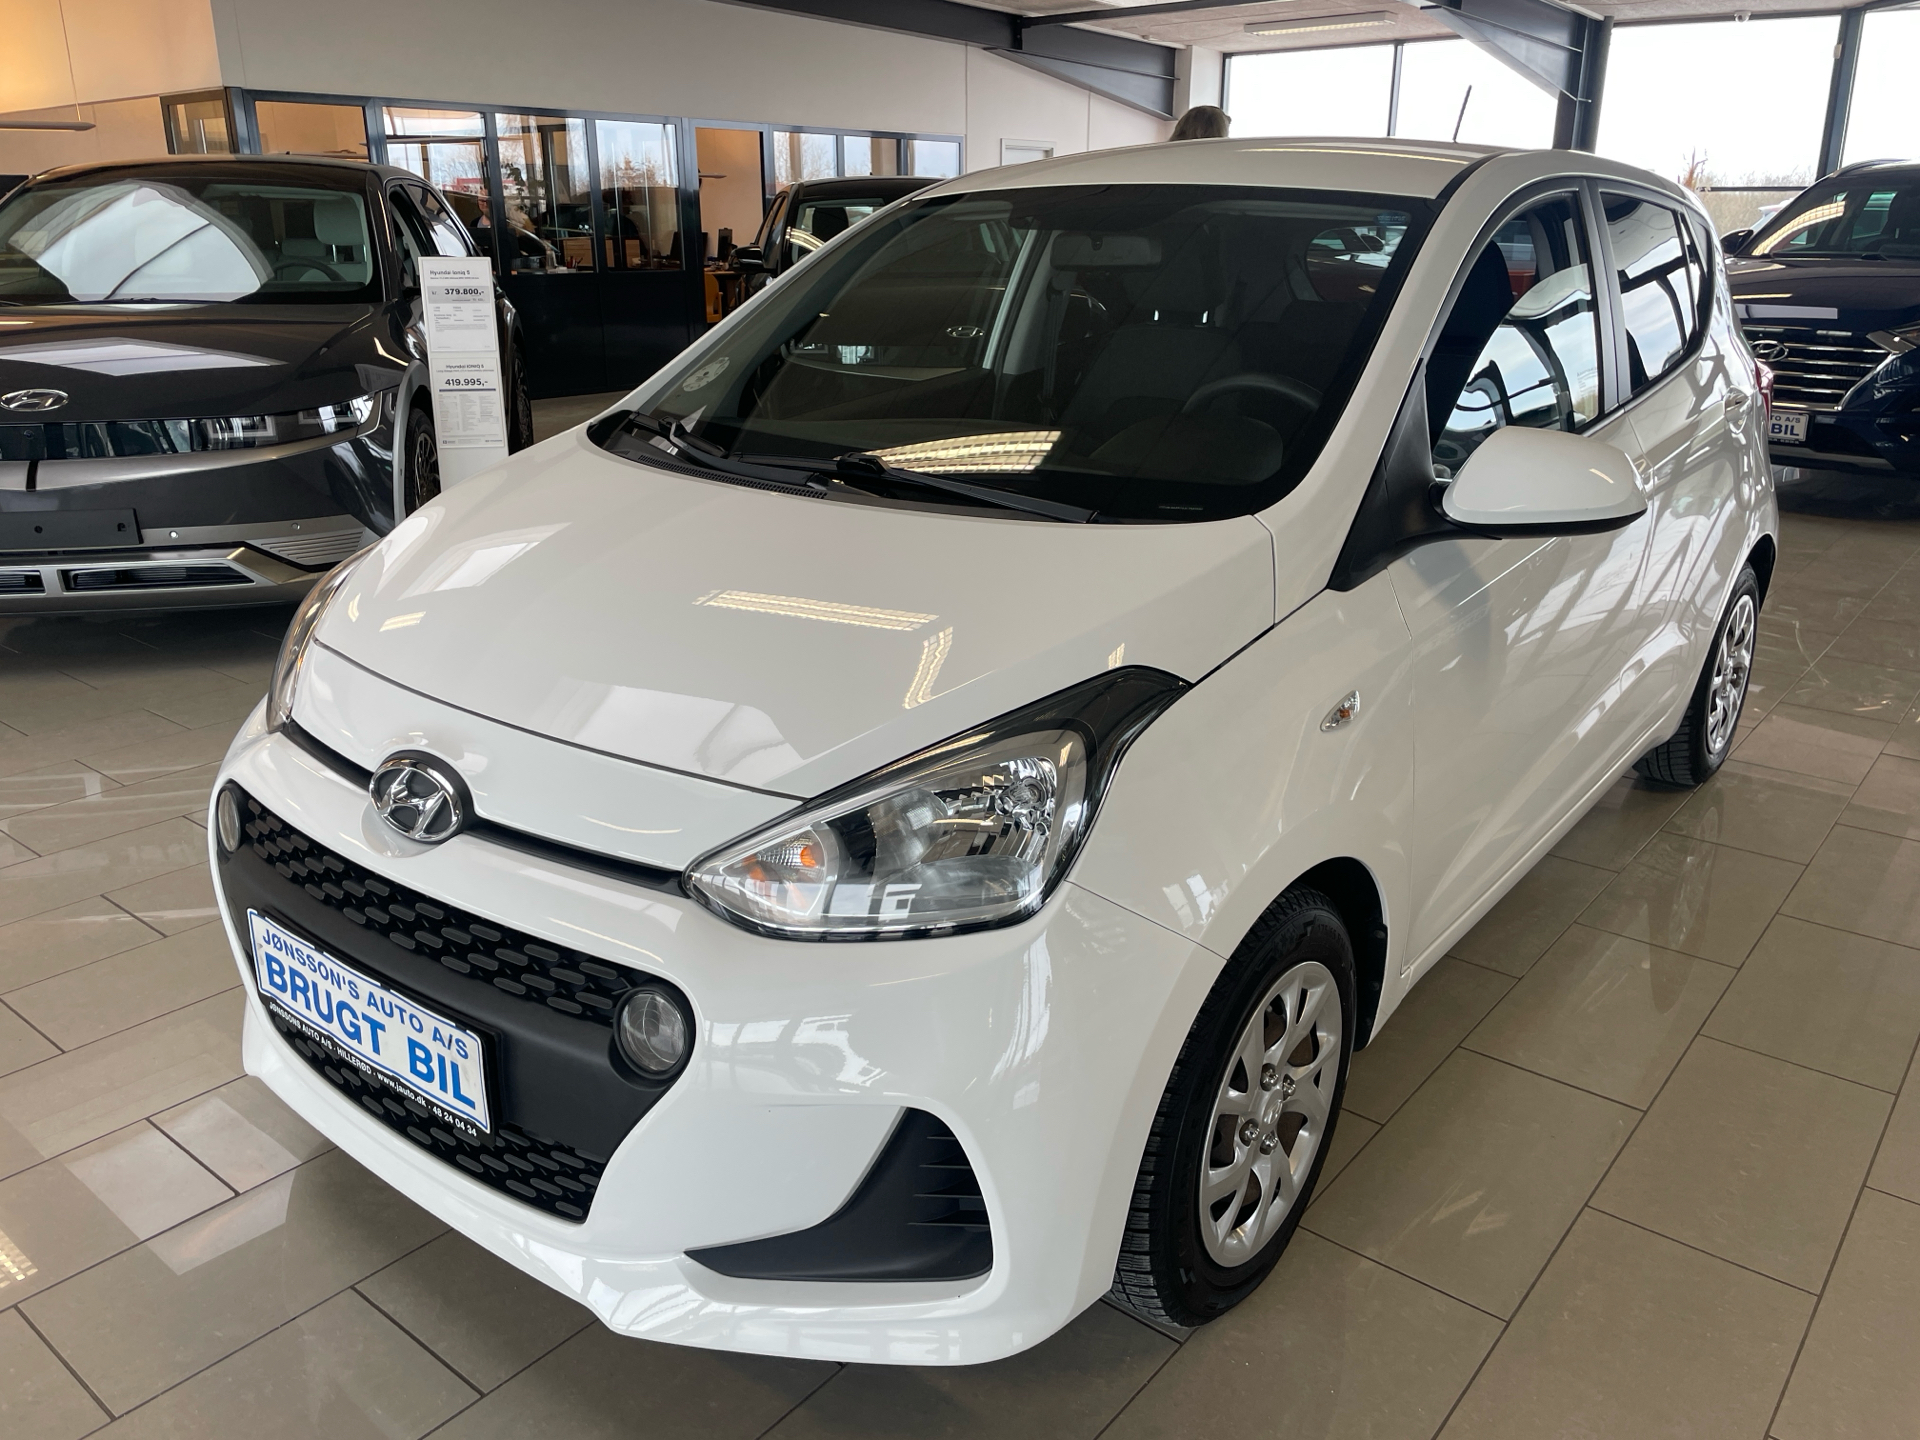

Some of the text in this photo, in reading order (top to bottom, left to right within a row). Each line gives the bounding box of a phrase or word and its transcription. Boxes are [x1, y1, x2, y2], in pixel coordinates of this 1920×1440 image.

[444, 288, 485, 296] 379.800,-
[445, 378, 488, 387] 419.995,-
[1770, 423, 1800, 436] BIL
[262, 929, 469, 1060] JØNSSON'S AUTO A/S
[264, 952, 476, 1110] BRUGT BIL
[302, 1024, 320, 1041] AUTO
[321, 1036, 333, 1050] A/S
[336, 1046, 372, 1074] HILLERØD
[377, 1073, 427, 1107] www.jauto.dk
[432, 1105, 443, 1117] 48
[444, 1112, 454, 1124] 24
[455, 1118, 465, 1131] 04
[467, 1124, 477, 1137] 34
